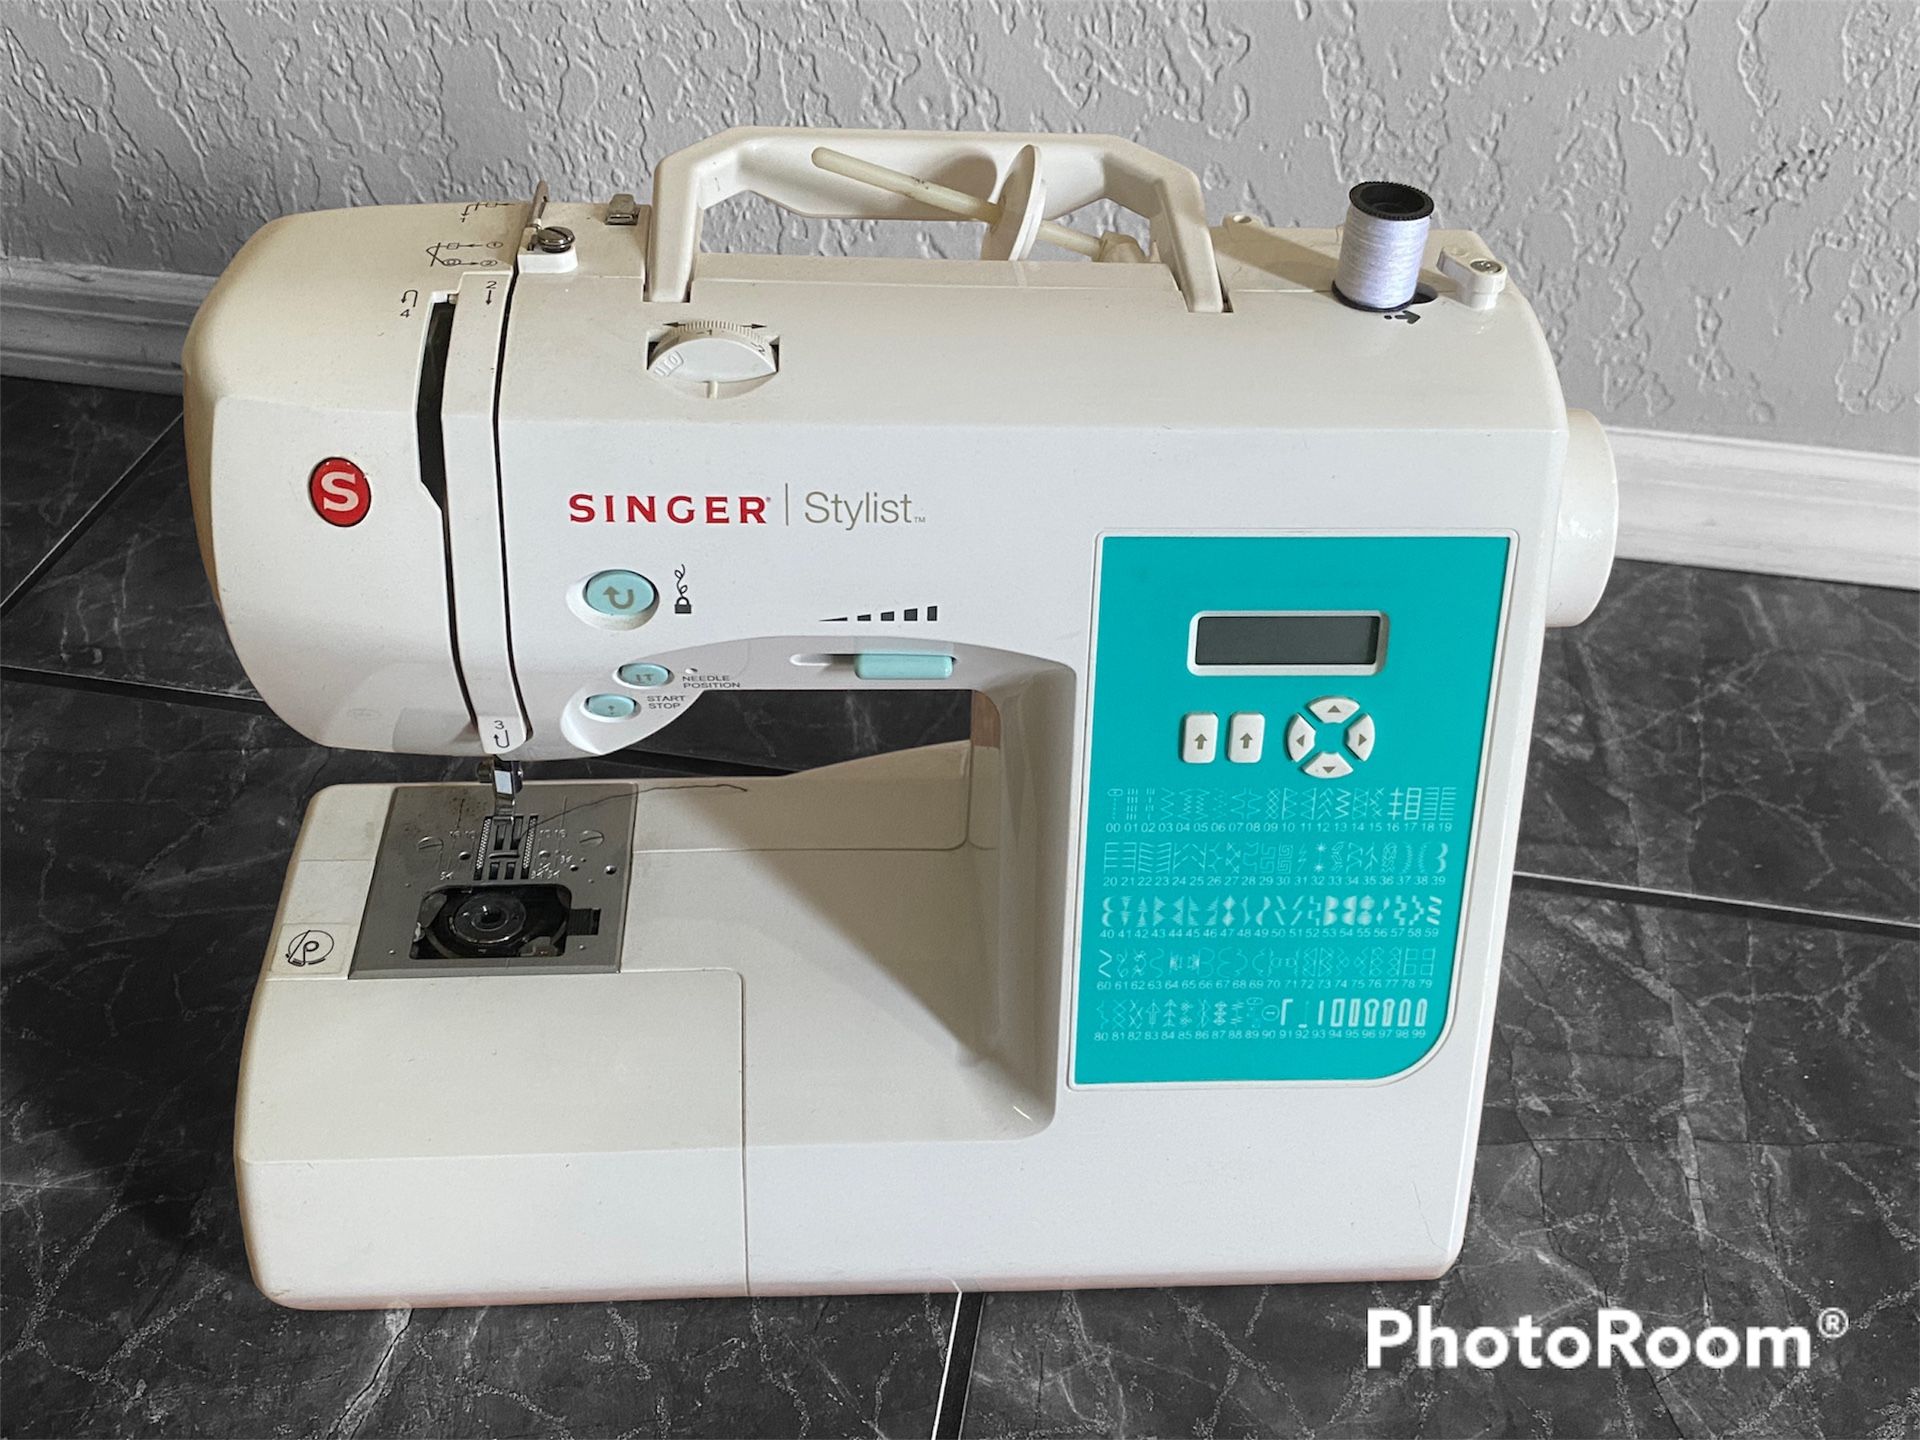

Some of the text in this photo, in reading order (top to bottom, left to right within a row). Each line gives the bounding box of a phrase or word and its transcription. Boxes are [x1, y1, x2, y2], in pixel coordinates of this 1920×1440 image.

[486, 280, 497, 289] 2
[400, 309, 410, 318] 4
[320, 471, 359, 512] S
[494, 719, 504, 730] 3
[1106, 822, 1452, 833] 00 01 02 03 04 05 06 07 08 09 10 11 12 13 14 15 16 17 18 19
[1103, 875, 1446, 887] 20 21 22 23 24 25 26 27 28 29 30 31 32 33 34 35 36 37 38 39
[1099, 927, 1439, 940] 40 41 42 43 44 45 46 47 48 49 50 51 52 53 54 55 56 57 58 59
[1096, 978, 1433, 991] 60 61 62 63 64 65 66 67 68 69 70 71 72 73 74 75 76 77 78 79
[1094, 1029, 1426, 1042] 80 81 82 83 84 85 86 87 88 89 90 91 92 93 94 95 96 97 98 99
